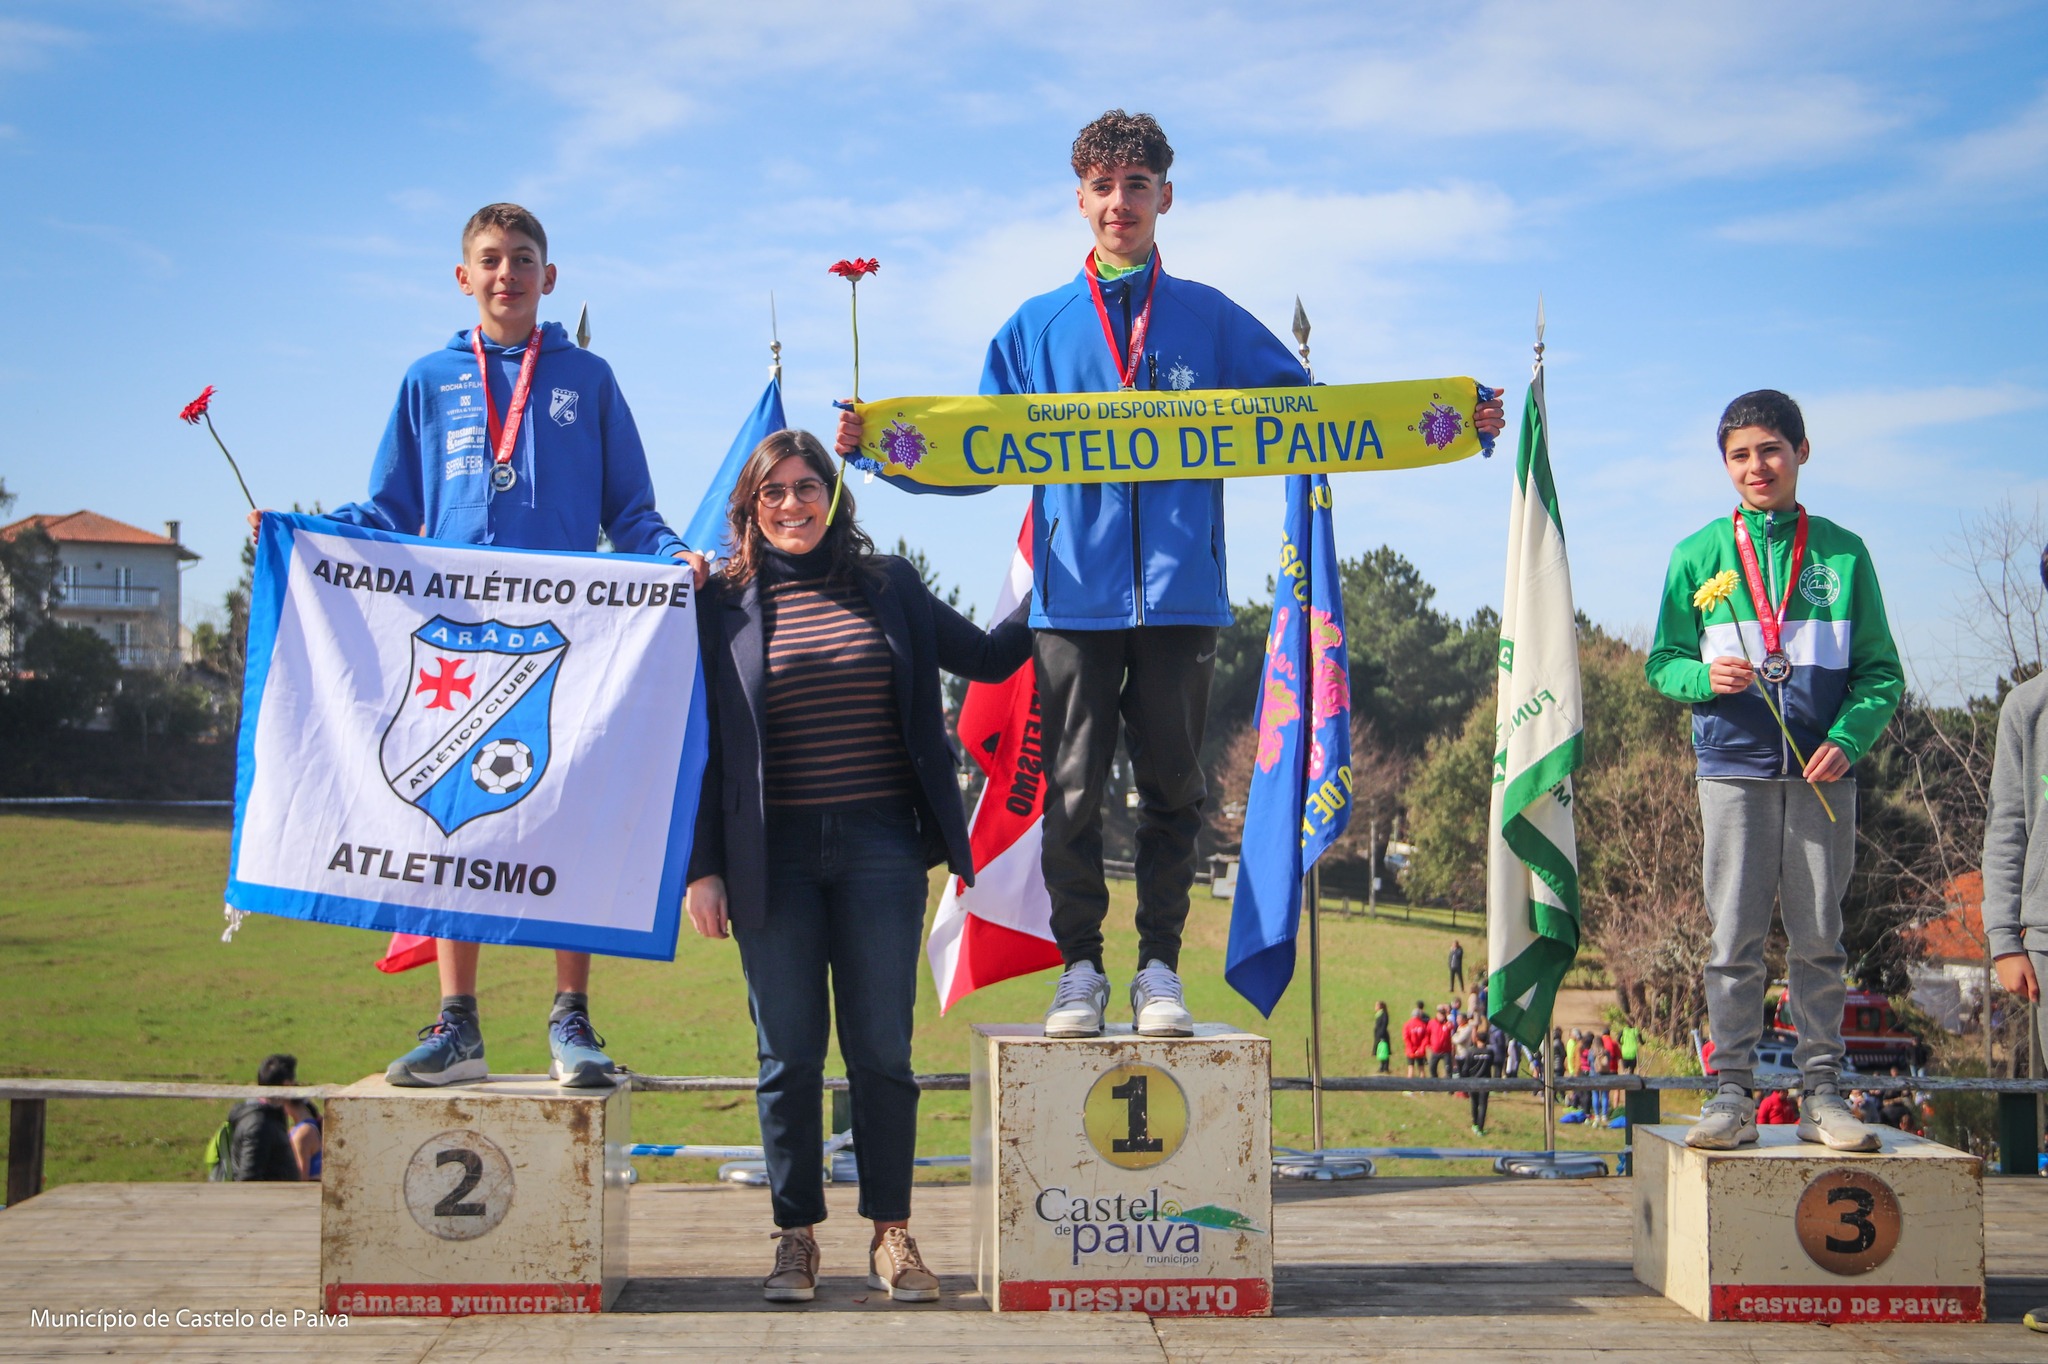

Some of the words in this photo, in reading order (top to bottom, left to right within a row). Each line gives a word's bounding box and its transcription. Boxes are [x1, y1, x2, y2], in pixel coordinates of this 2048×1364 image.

[441, 383, 463, 392] ROCHA
[1028, 403, 1091, 422] GRUPO
[1097, 400, 1207, 420] DESPORTIVO
[1215, 399, 1225, 416] E
[1232, 395, 1319, 415] CULTURAL
[962, 425, 1159, 474] CASTELO
[1179, 425, 1236, 468] DE
[1255, 416, 1384, 465] PAIVA
[313, 559, 414, 596] ARADA
[423, 570, 576, 605] ATLÉTICO
[586, 578, 690, 609] CLUBE
[432, 627, 549, 648] ARADA
[408, 716, 483, 789] ATLÉTICO
[485, 660, 538, 714] CLUBE
[328, 843, 557, 896] ATLETISMO
[1111, 1075, 1163, 1153] 1
[434, 1149, 487, 1217] 2
[1054, 1223, 1071, 1236] de
[1072, 1222, 1200, 1266] paiva
[1825, 1187, 1877, 1254] 3
[1146, 1254, 1199, 1265] município
